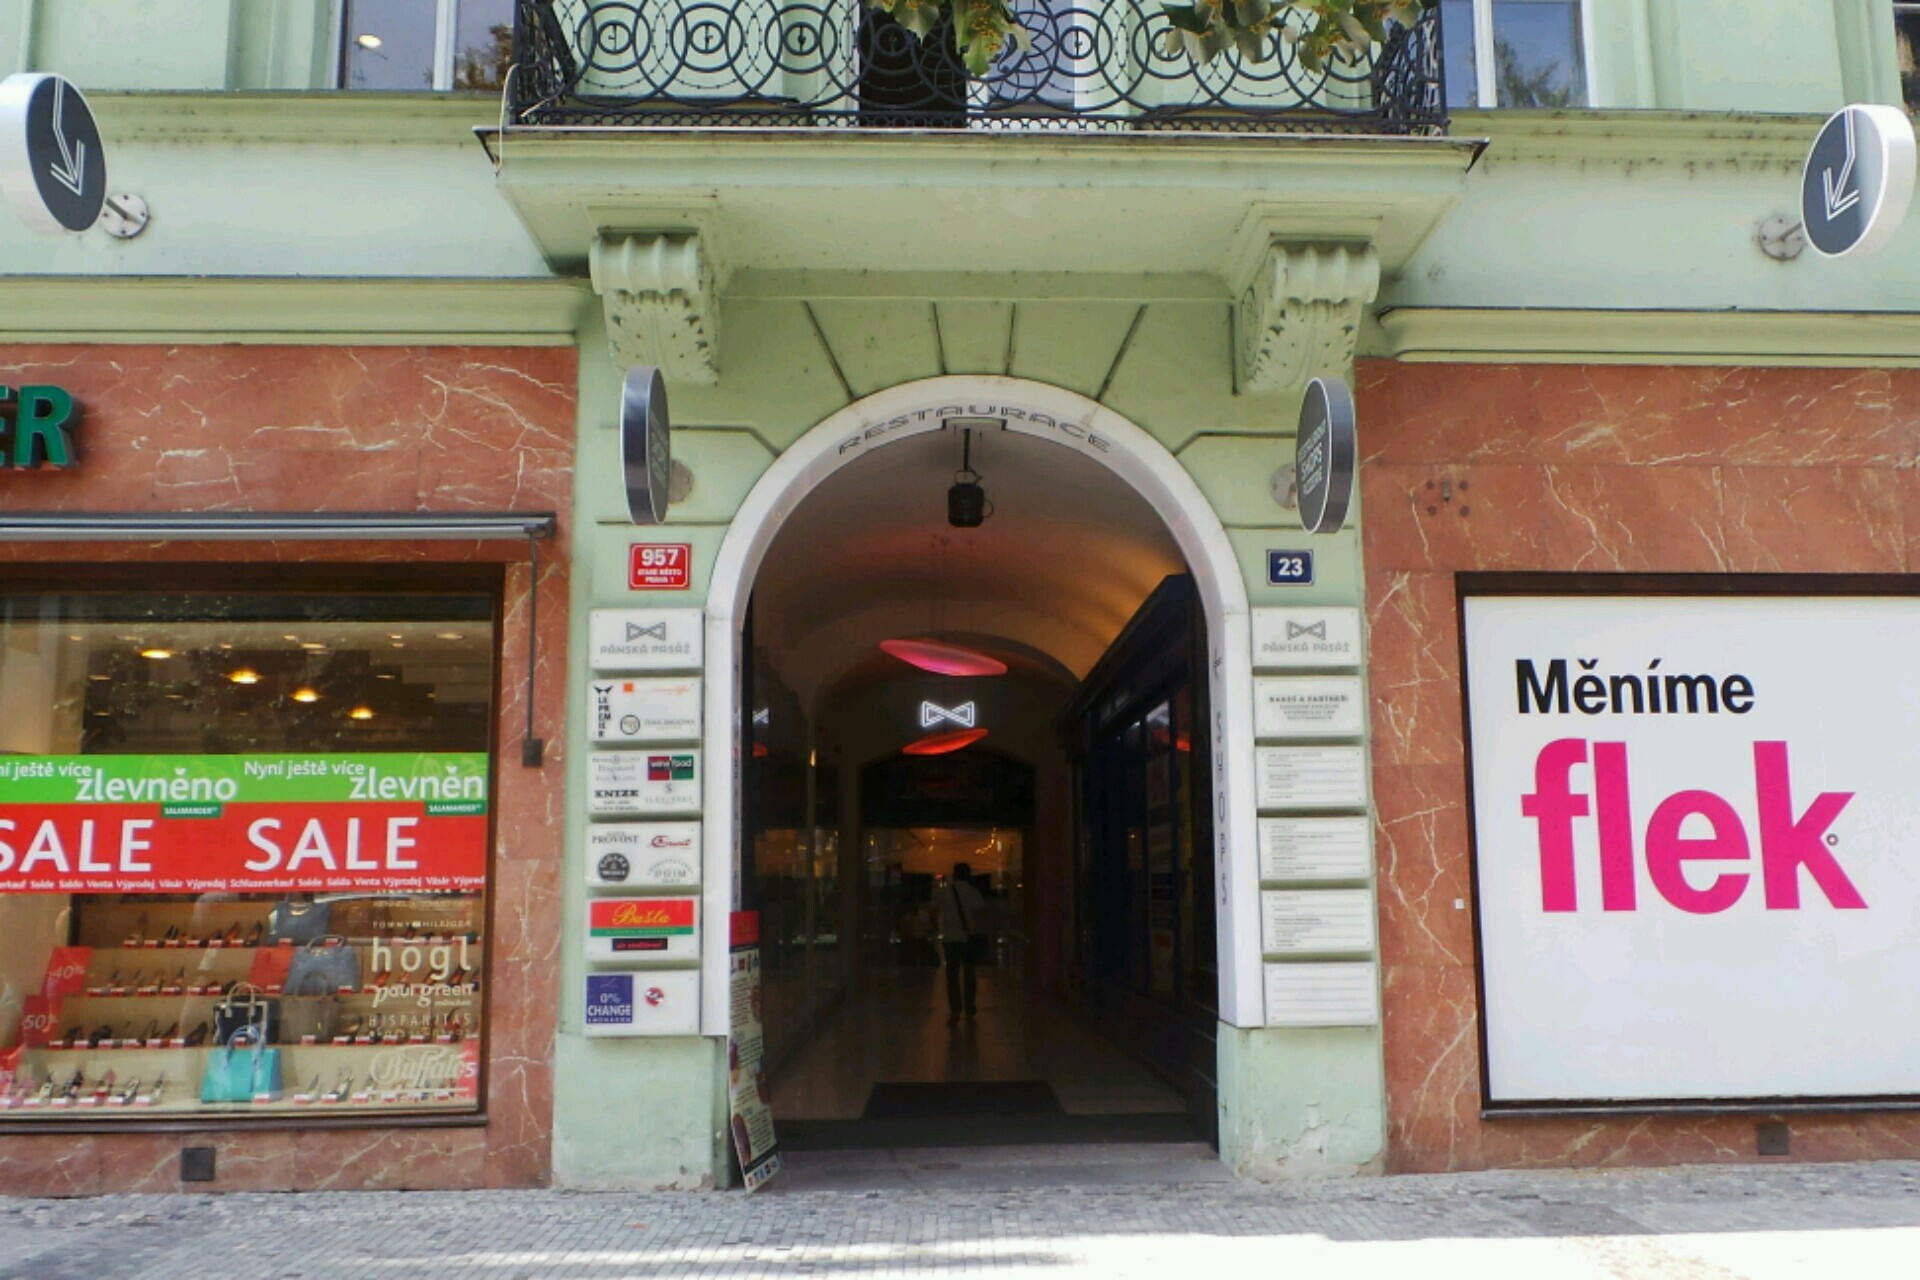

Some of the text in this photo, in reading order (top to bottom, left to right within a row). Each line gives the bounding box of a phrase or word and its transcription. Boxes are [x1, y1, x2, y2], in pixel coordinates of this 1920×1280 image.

[0, 384, 73, 466] R
[838, 403, 1111, 455] RESTAURACE
[641, 548, 679, 566] 957
[1277, 558, 1304, 576] 23
[600, 643, 690, 655] PÁNSKÁ PASÁŽ
[1262, 641, 1350, 653] PÁNSKÁ PASÁŽ
[1515, 658, 1755, 715] Měníme
[12, 762, 54, 781] ještě
[59, 762, 92, 777] více
[244, 760, 365, 779] Nyní ještě více
[75, 767, 238, 802] zlevněno
[1521, 738, 1869, 914] flek
[244, 817, 419, 871] SALE
[600, 992, 622, 1005] 0%
[587, 1004, 632, 1017] CHANGE
